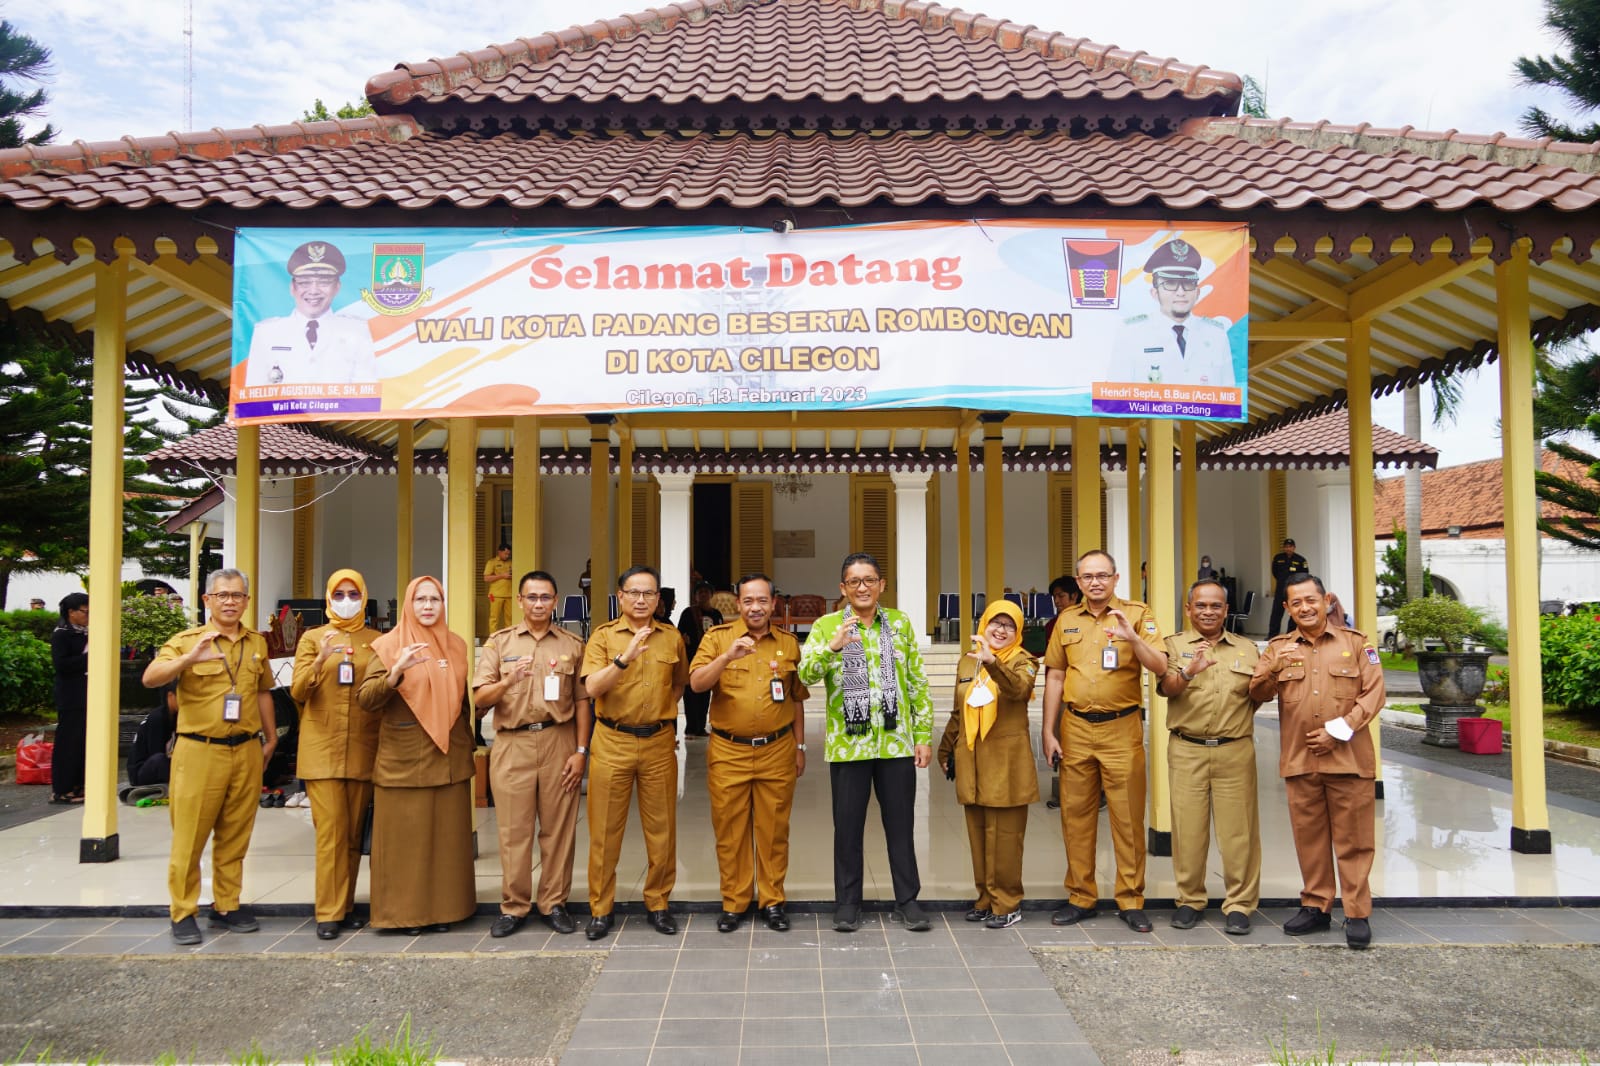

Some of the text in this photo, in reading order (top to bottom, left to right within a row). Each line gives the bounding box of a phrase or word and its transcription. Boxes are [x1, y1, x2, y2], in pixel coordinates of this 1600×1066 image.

[528, 252, 964, 290] Selamat Datang
[416, 307, 1072, 342] WALI KOTA PADANG BESERTA ROMBONGAN
[606, 347, 880, 374] DI KOTA CILEGON
[626, 387, 867, 408] Cilegon, 13 Februari 2023
[1100, 387, 1236, 403] Hendri Septa, B.Bus (Acc), MIB
[272, 401, 339, 411] Wali Kota Cilegon
[1129, 402, 1211, 416] Wali kota Padang
